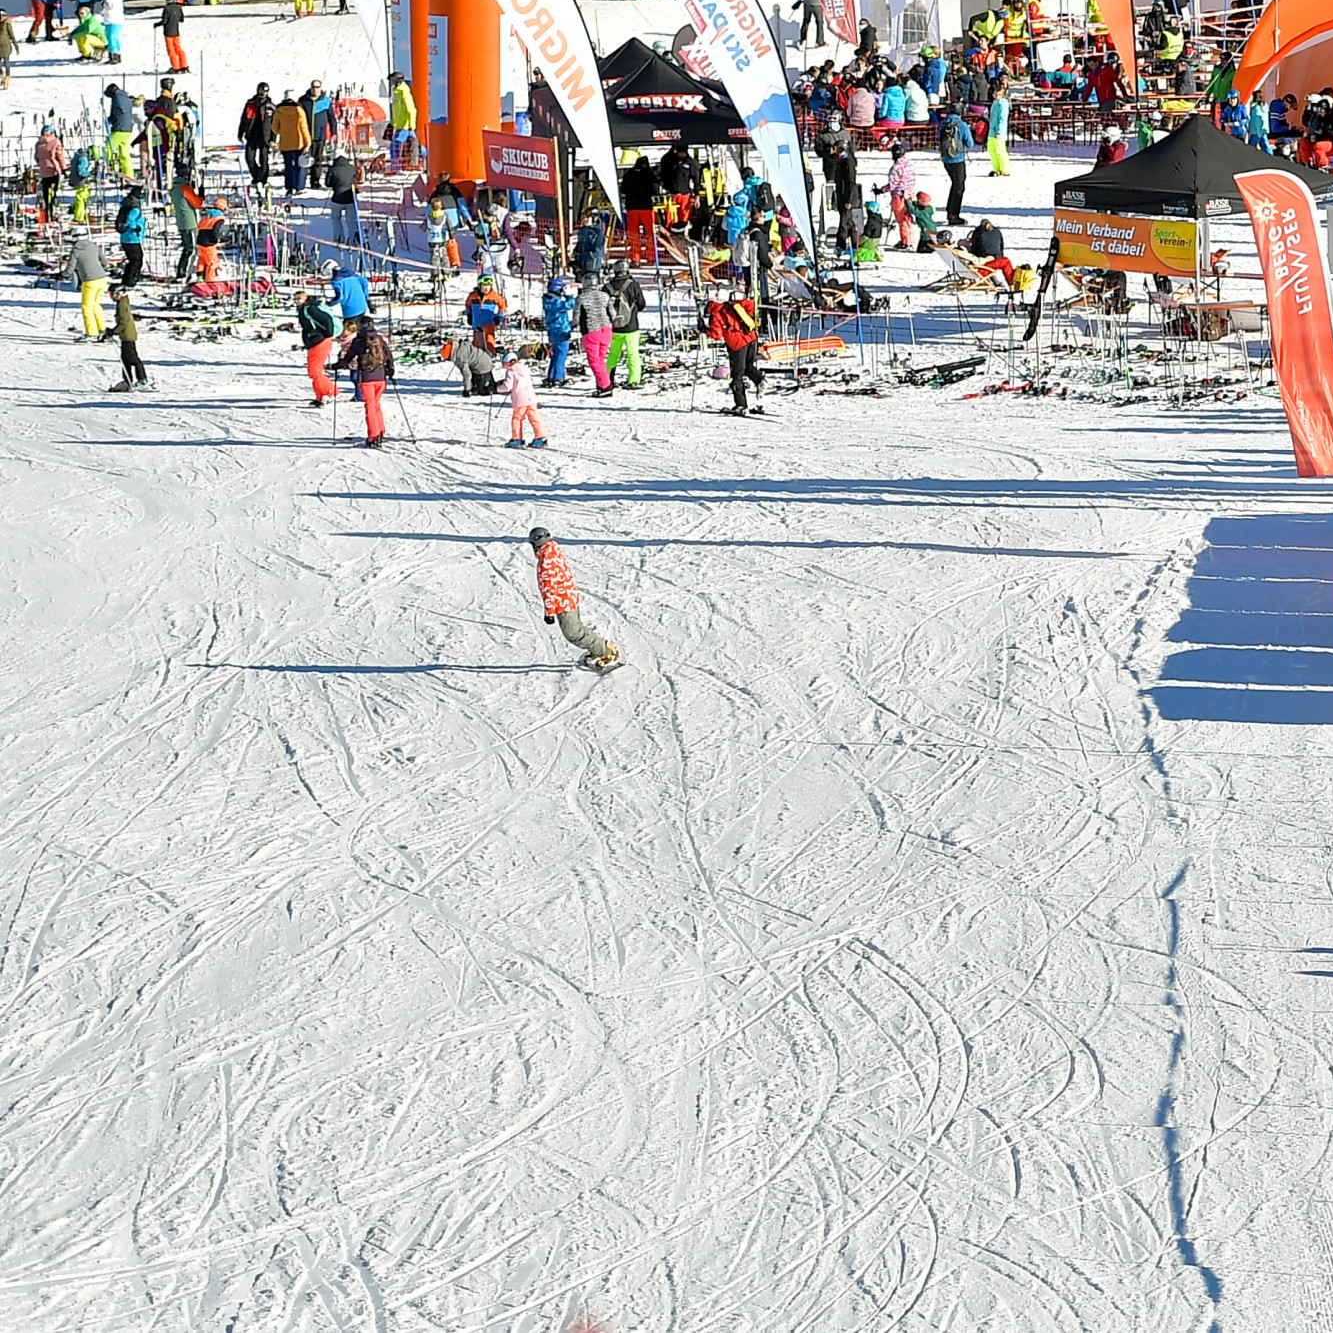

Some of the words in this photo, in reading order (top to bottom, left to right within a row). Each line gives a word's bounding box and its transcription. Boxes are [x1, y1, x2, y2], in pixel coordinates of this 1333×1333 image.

[615, 95, 708, 112] SPORTXX
[502, 147, 549, 169] SKICLUB
[1056, 219, 1083, 234] Mein
[1086, 223, 1135, 240] Verband
[1154, 228, 1178, 238] Sport-
[1091, 239, 1107, 252] ist
[1107, 240, 1146, 257] dabei!
[1159, 237, 1193, 248] verein-t
